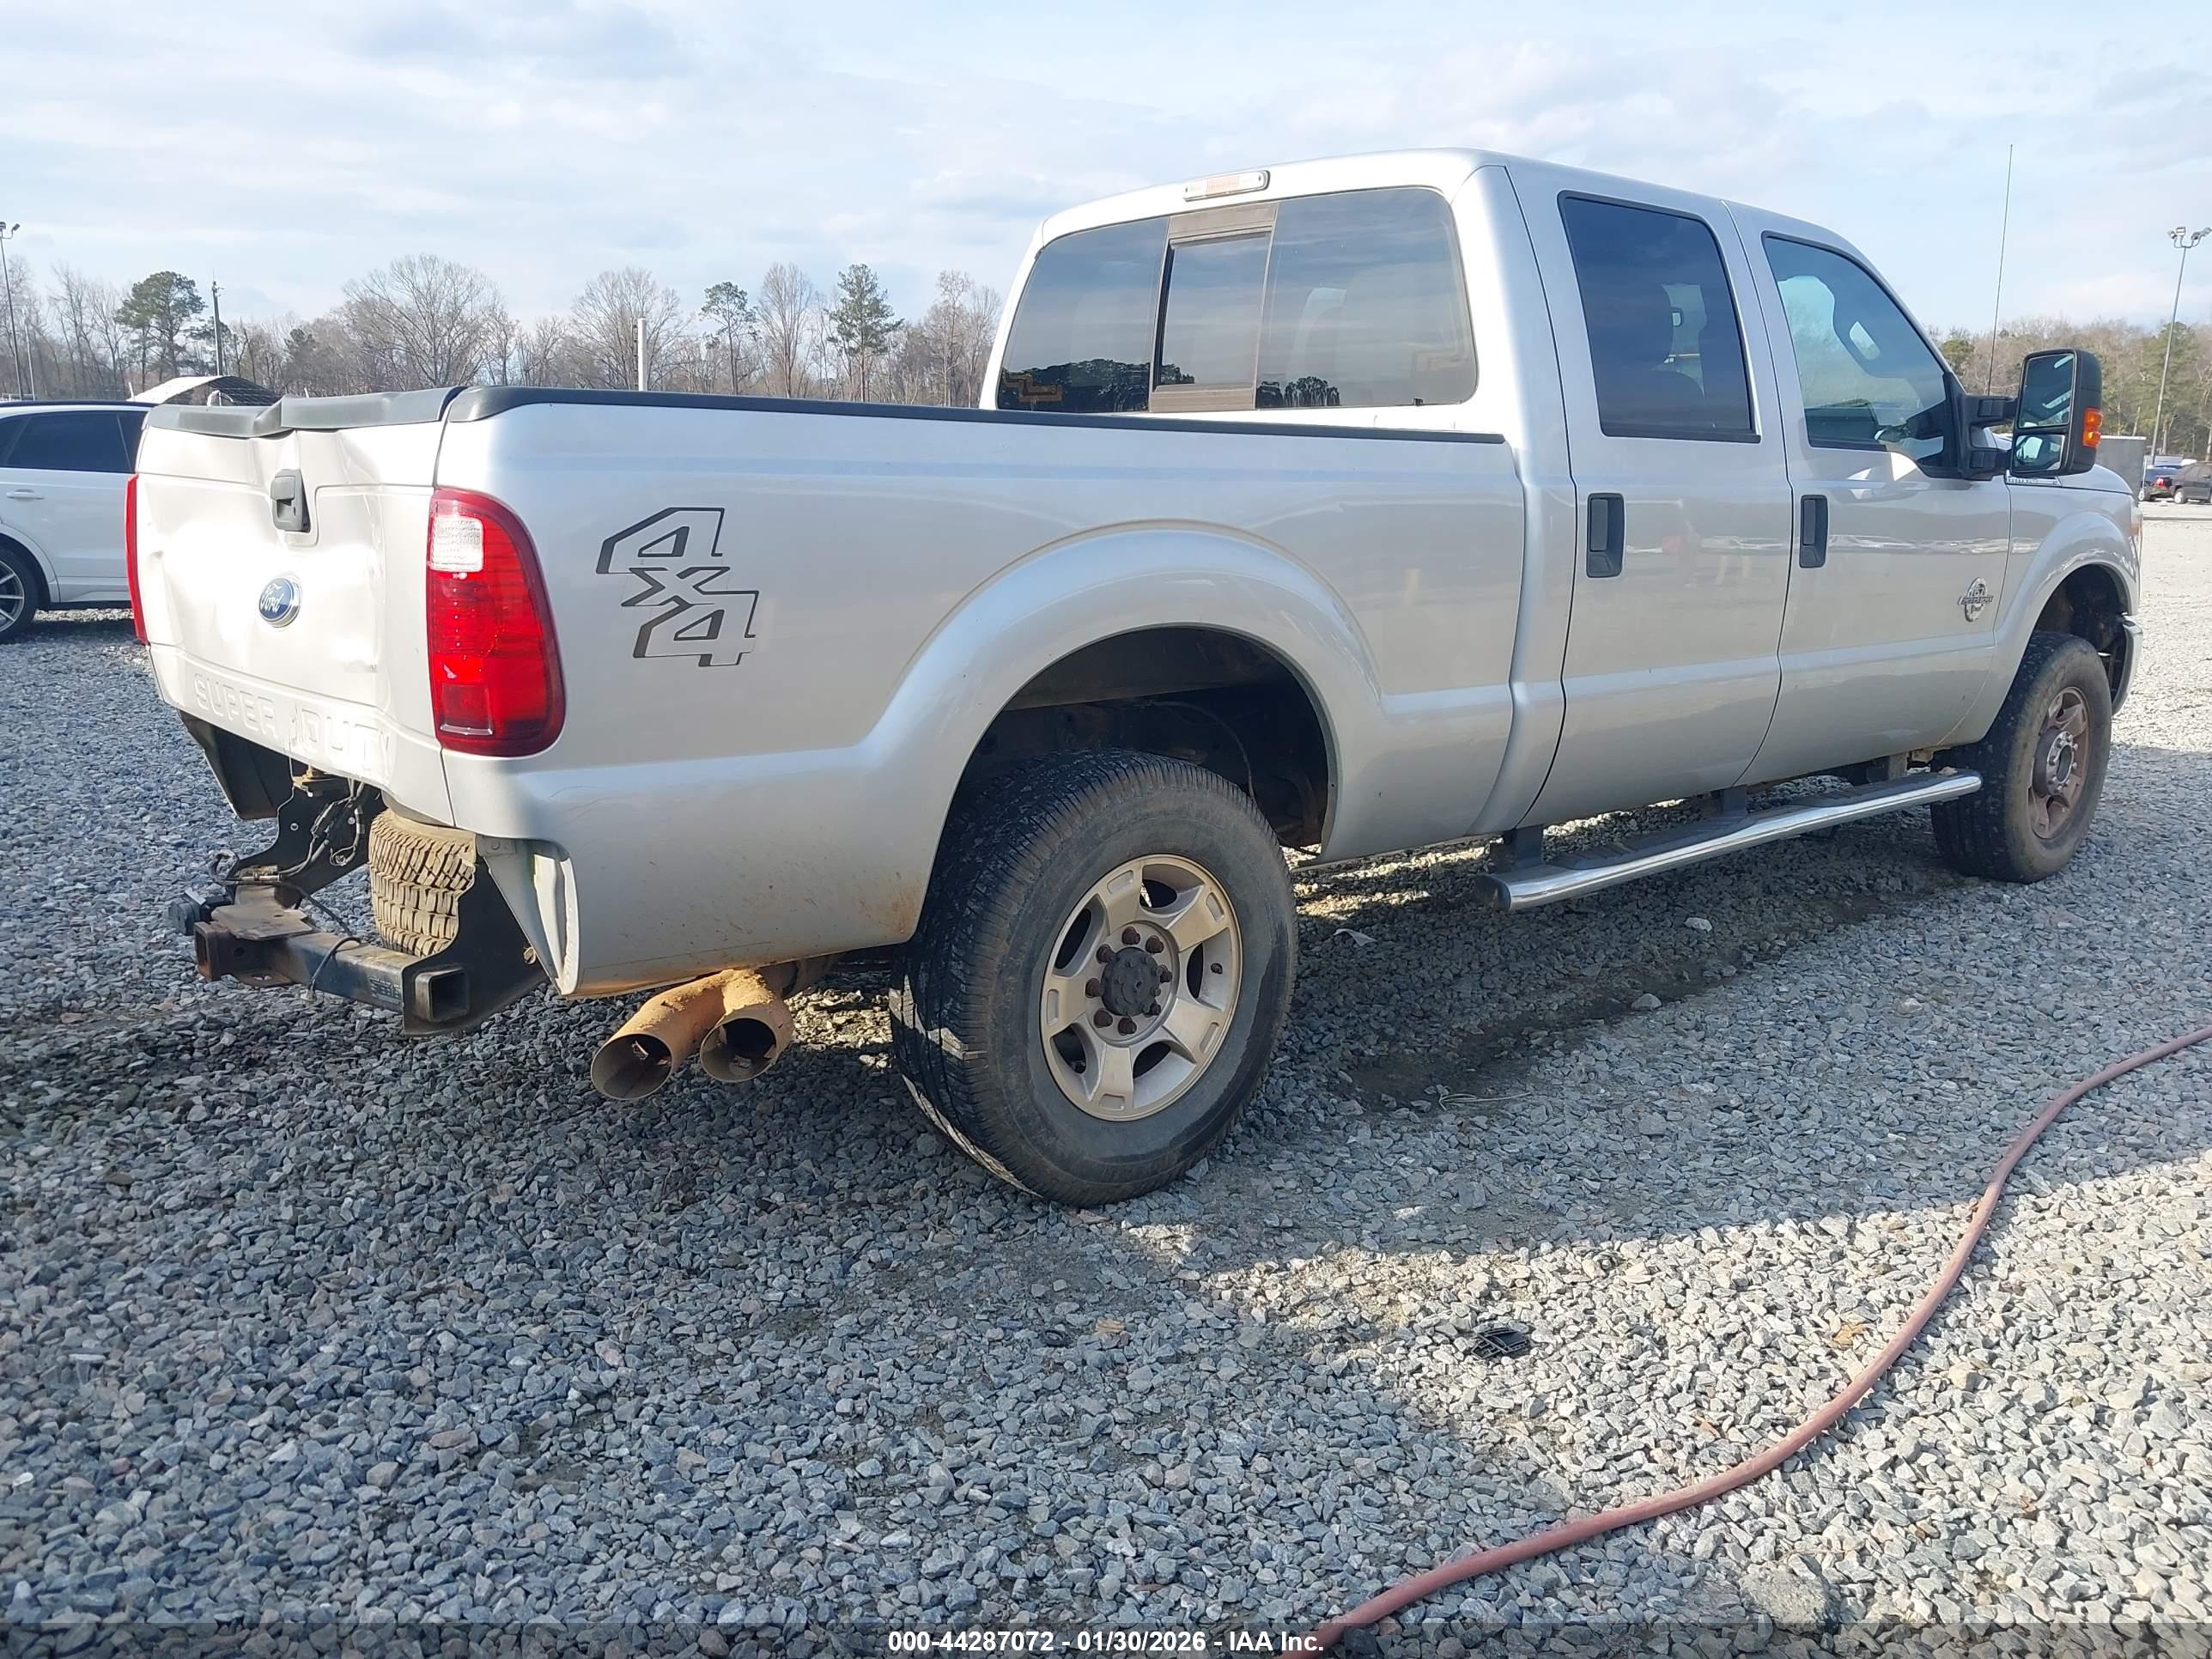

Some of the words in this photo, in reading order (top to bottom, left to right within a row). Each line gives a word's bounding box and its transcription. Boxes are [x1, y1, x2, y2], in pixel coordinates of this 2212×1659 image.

[260, 582, 285, 613] Ford
[192, 672, 280, 740] SUPER
[296, 706, 392, 776] DUTY
